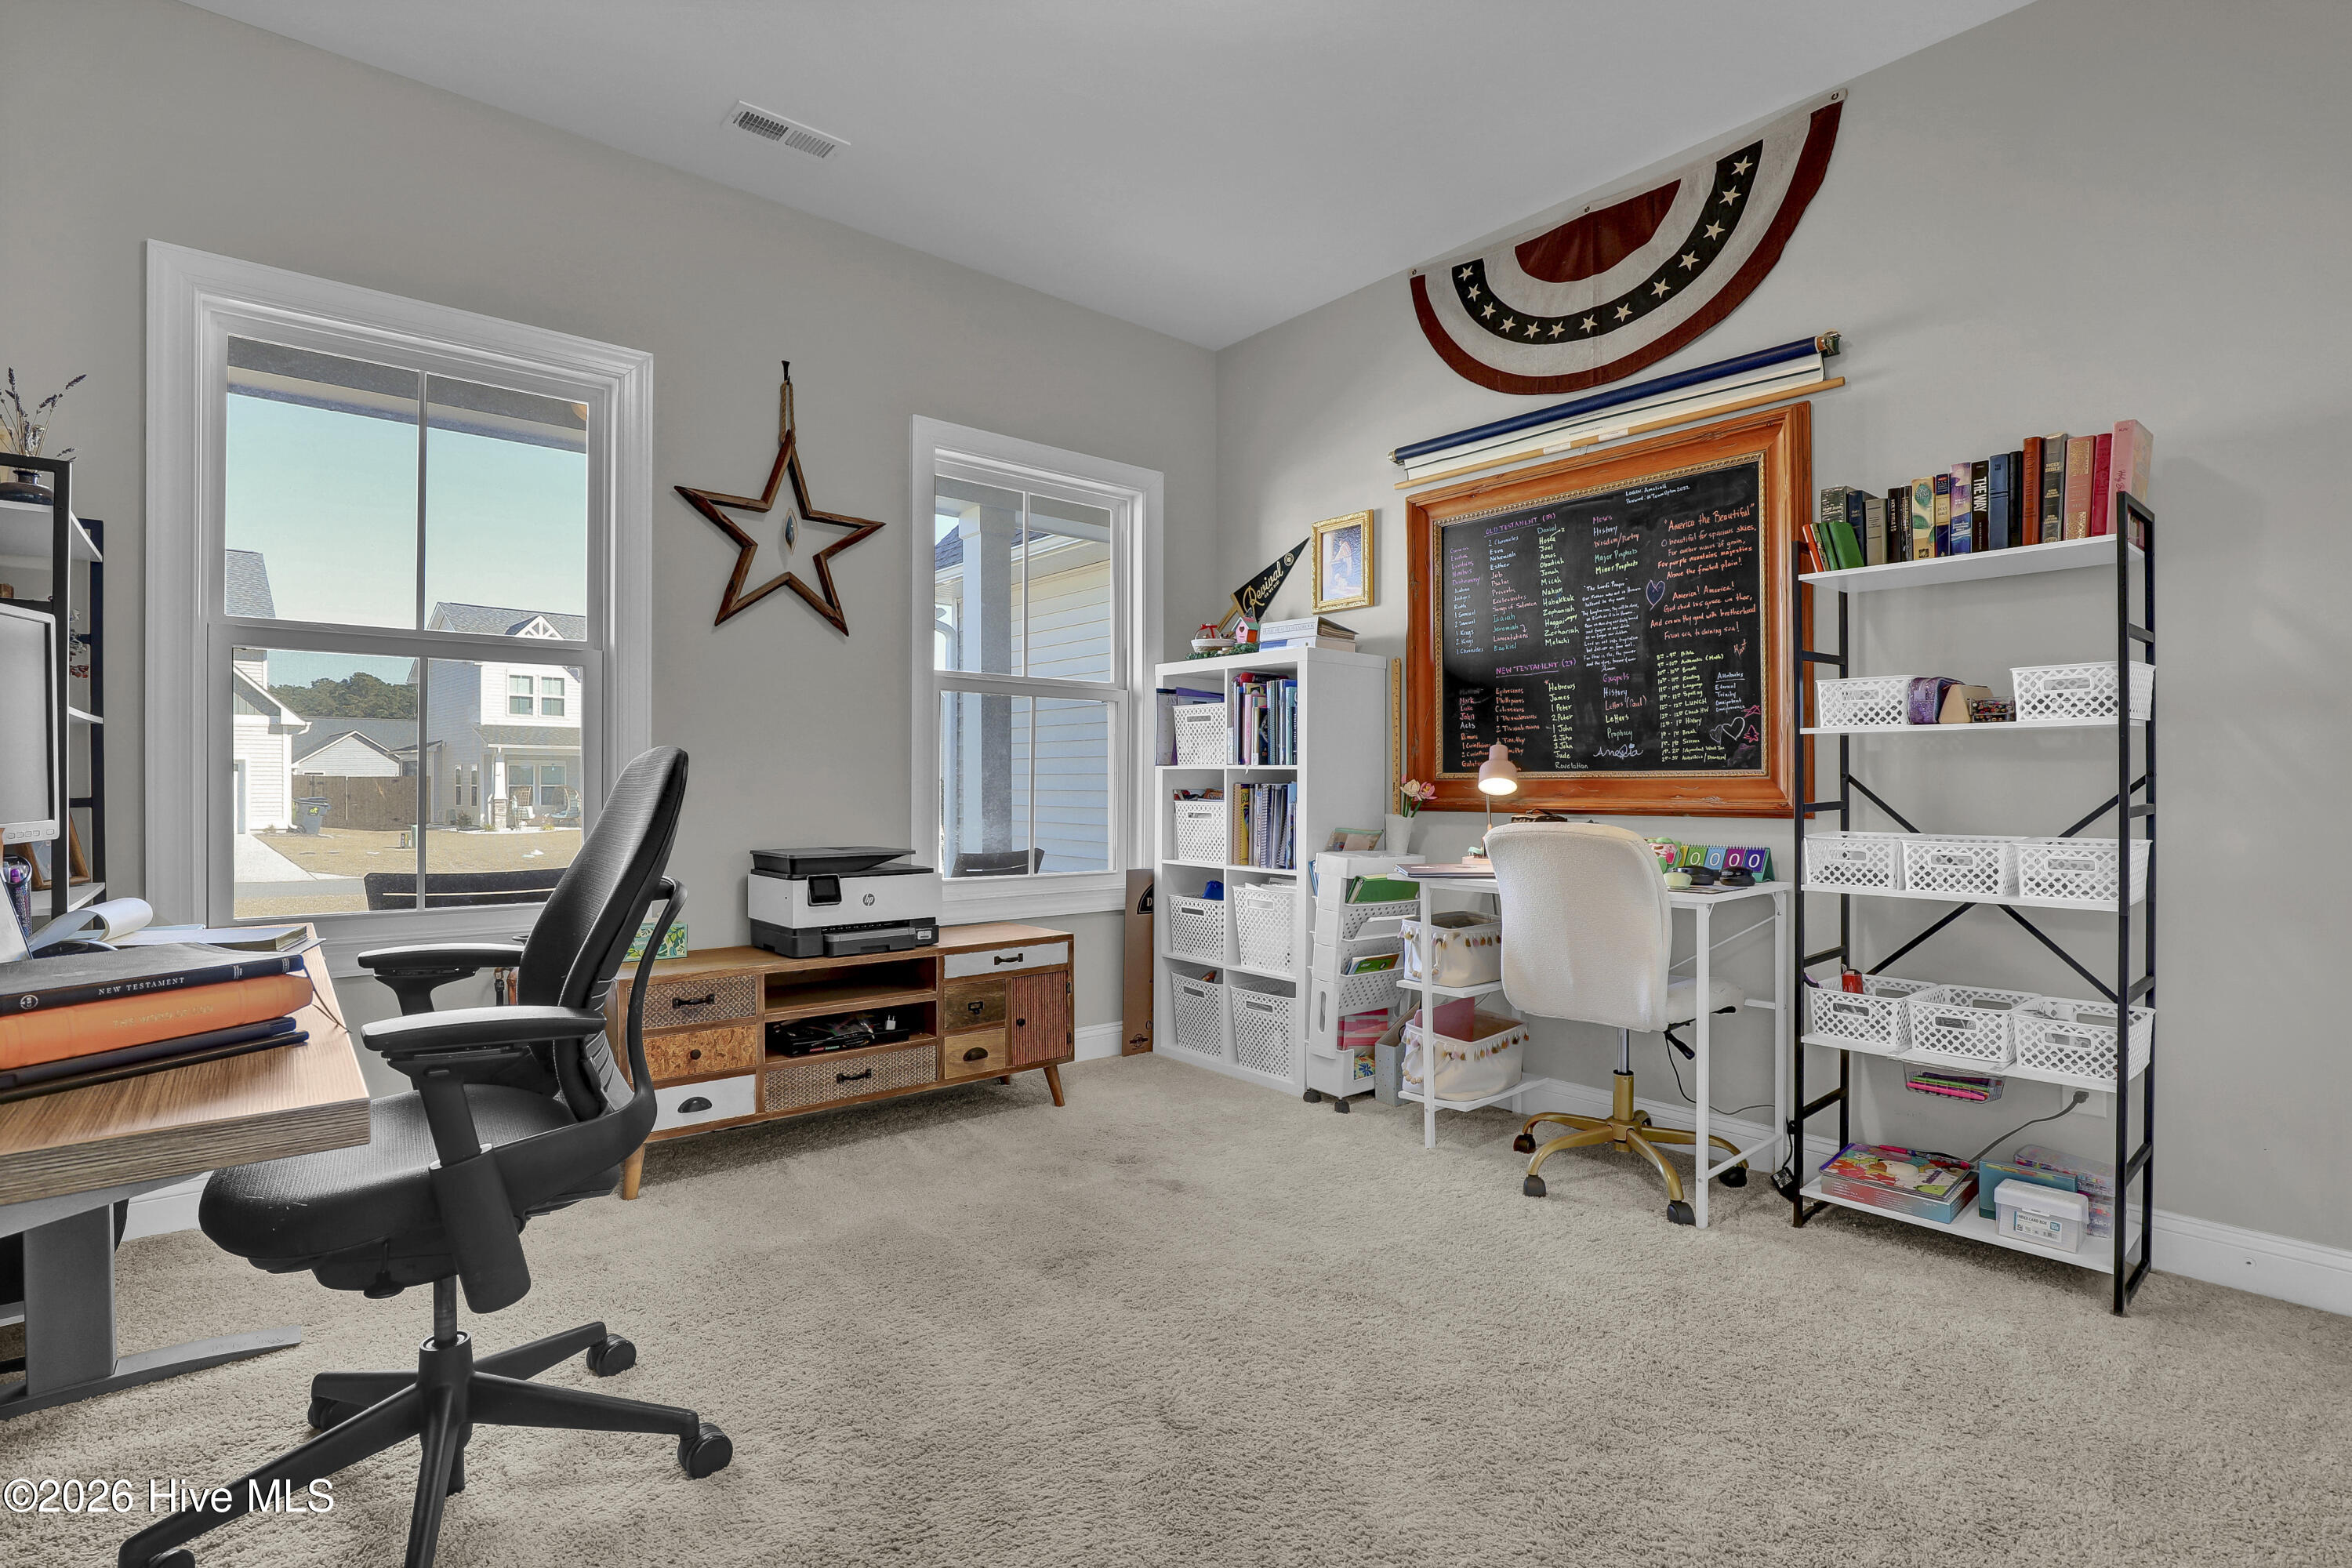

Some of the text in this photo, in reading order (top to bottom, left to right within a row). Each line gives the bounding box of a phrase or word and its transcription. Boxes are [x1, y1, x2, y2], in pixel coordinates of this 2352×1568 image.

[1974, 477, 1987, 493] THE
[1974, 494, 1987, 512] WAY
[1501, 517, 1537, 531] TESTAMENT
[1699, 513, 1710, 524] the
[1537, 524, 1557, 534] Daniel
[1593, 525, 1618, 536] History
[1539, 535, 1556, 544] Hosea
[1540, 558, 1565, 568] Obadiah
[1595, 553, 1613, 564] Major
[1669, 557, 1687, 569] purple
[1595, 565, 1614, 575] Minor
[1243, 561, 1283, 619] Revival
[1542, 587, 1563, 596] Nahum
[1543, 595, 1575, 607] Habakkuk
[1543, 606, 1575, 617] Zephaniah
[1650, 619, 1662, 628] And
[1720, 604, 1756, 616] brotherhood
[1544, 618, 1565, 629] Haggai
[1514, 662, 1559, 672] TESTAMENT
[1548, 683, 1576, 691] Hebrews
[1549, 694, 1570, 702] James
[1604, 687, 1628, 702] History
[1606, 714, 1629, 724] Letters
[1748, 855, 1760, 868] 0
[98, 978, 185, 995] NEW TESTAMENT
